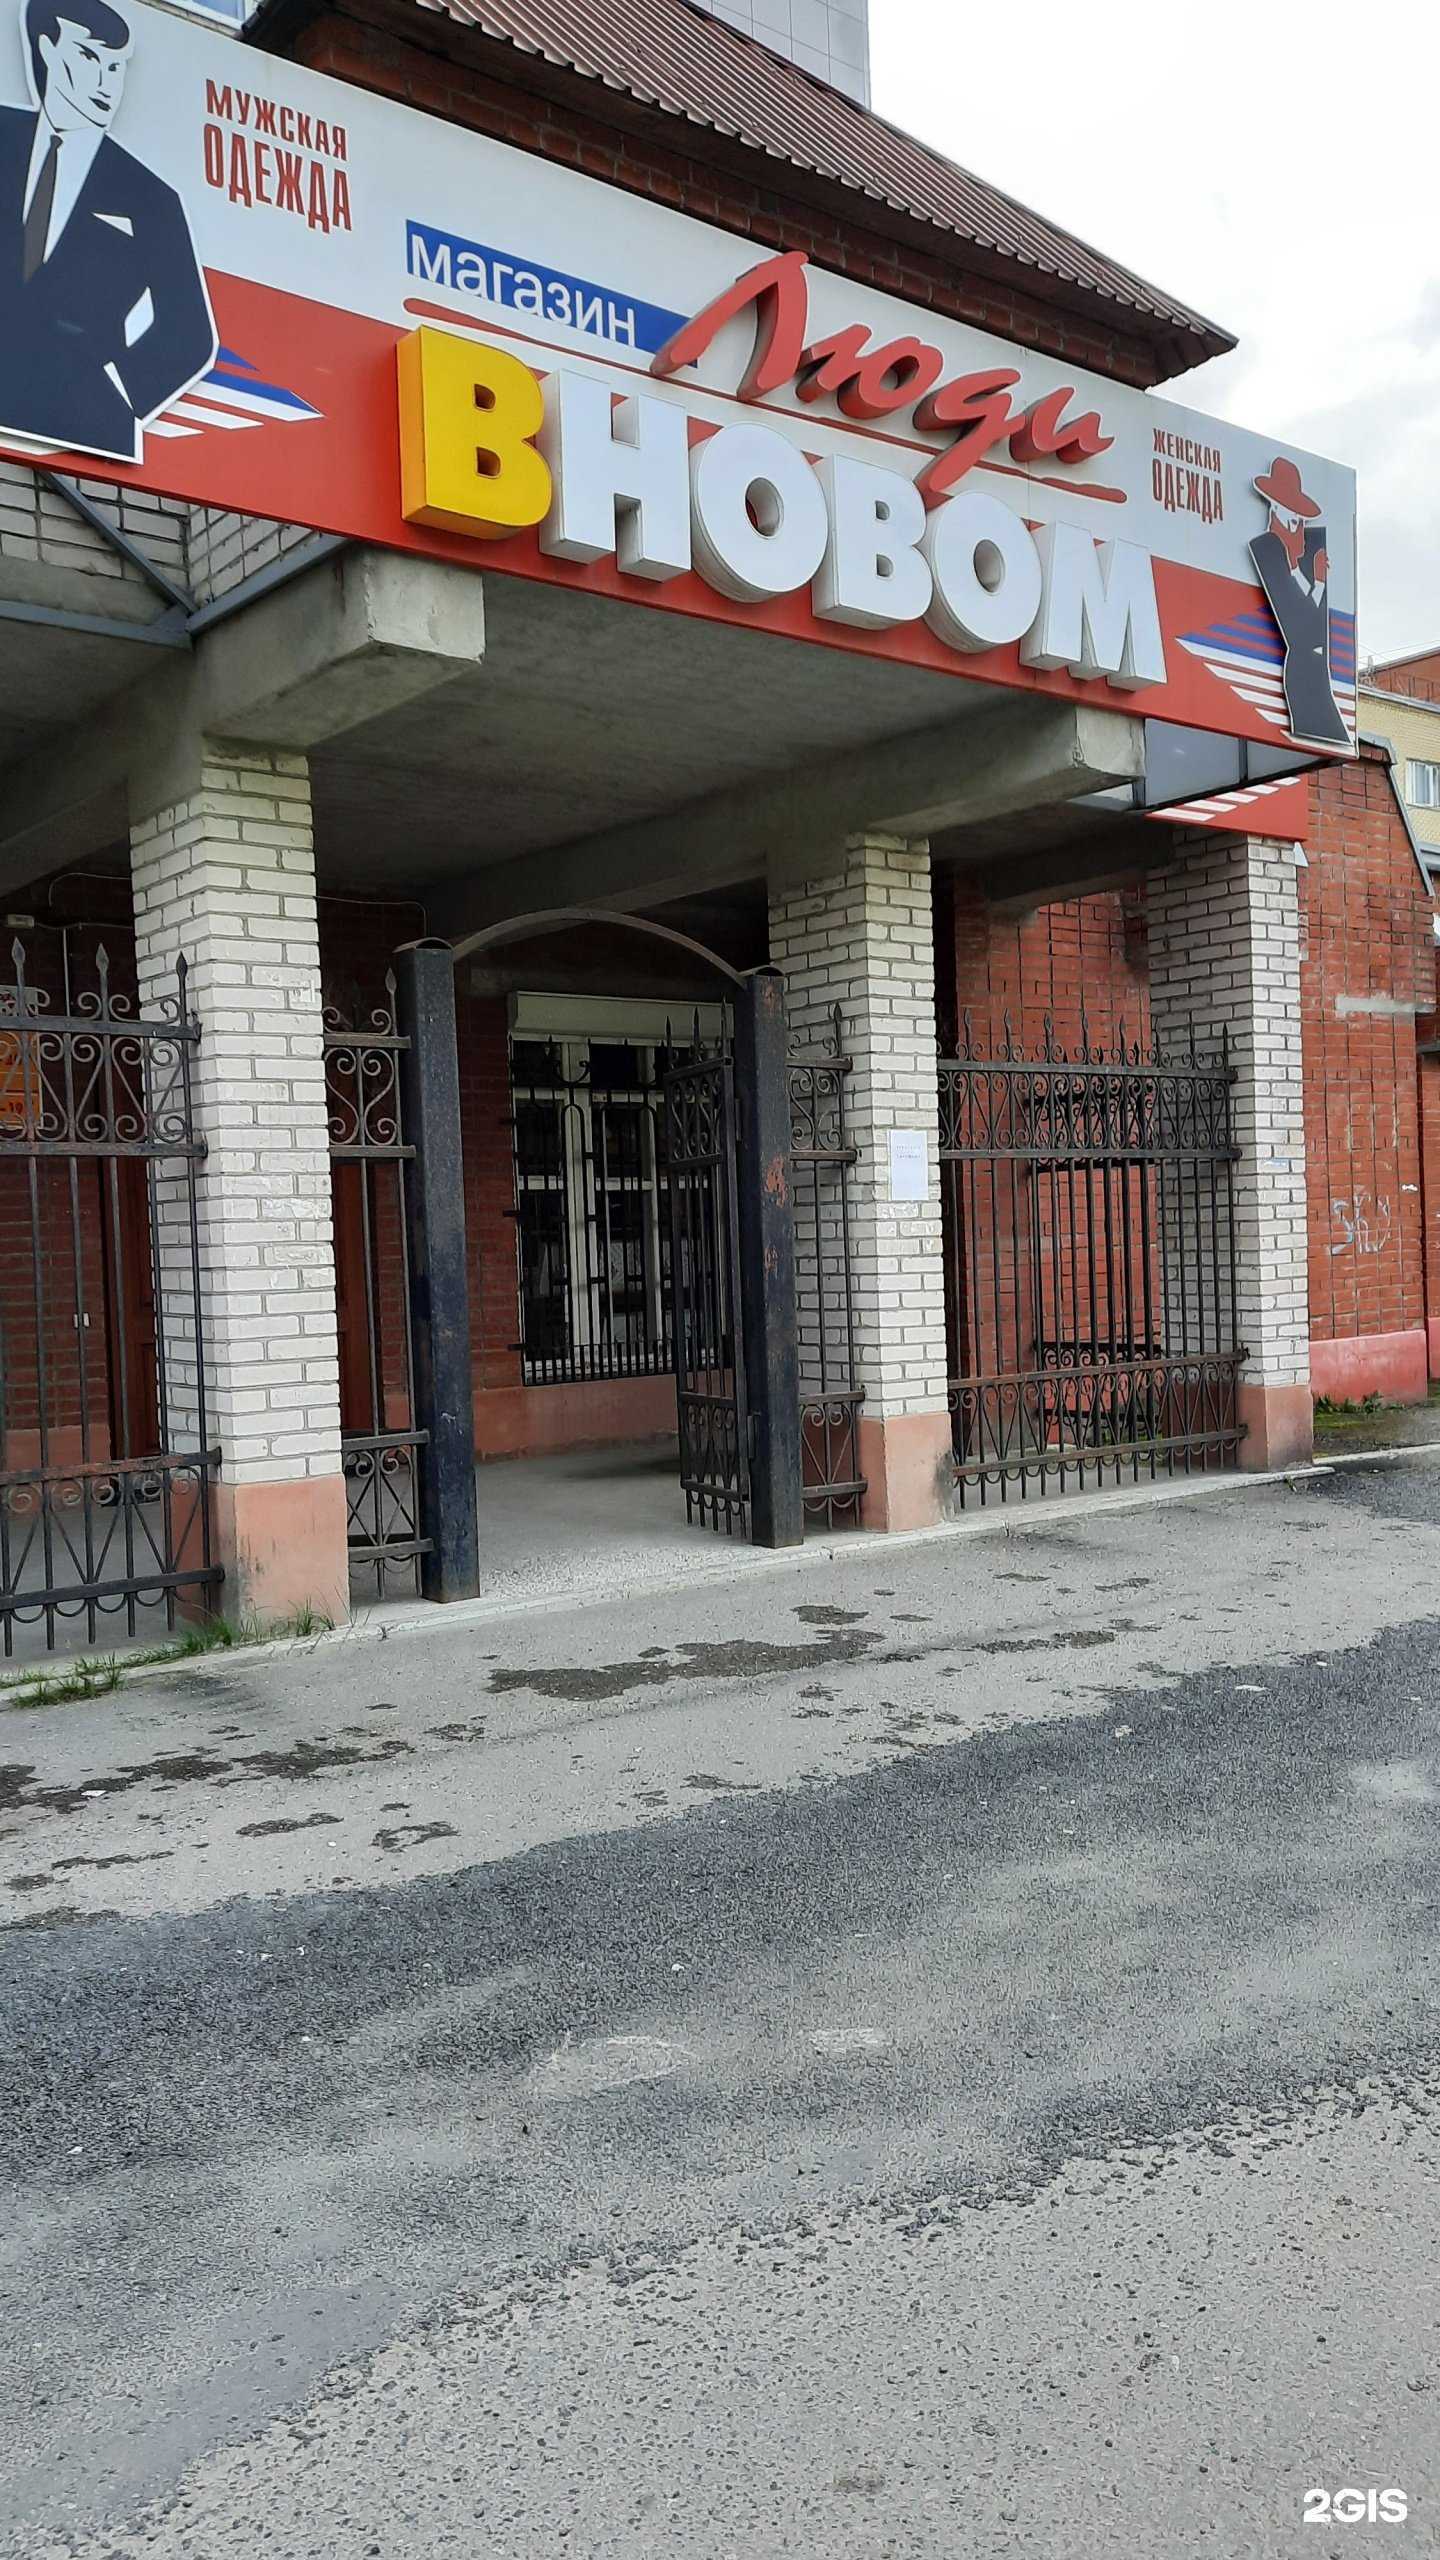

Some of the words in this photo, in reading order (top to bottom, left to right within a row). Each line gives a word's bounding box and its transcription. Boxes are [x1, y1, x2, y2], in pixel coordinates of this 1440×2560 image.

[205, 78, 348, 161] МУЖСКАЯ
[203, 123, 352, 234] ОДЕЖДА
[411, 233, 636, 348] магазин
[652, 251, 1115, 492] Люди
[1152, 458, 1223, 524] ОДЕЖДА
[1153, 427, 1221, 473] ЖЕНСКАЯ
